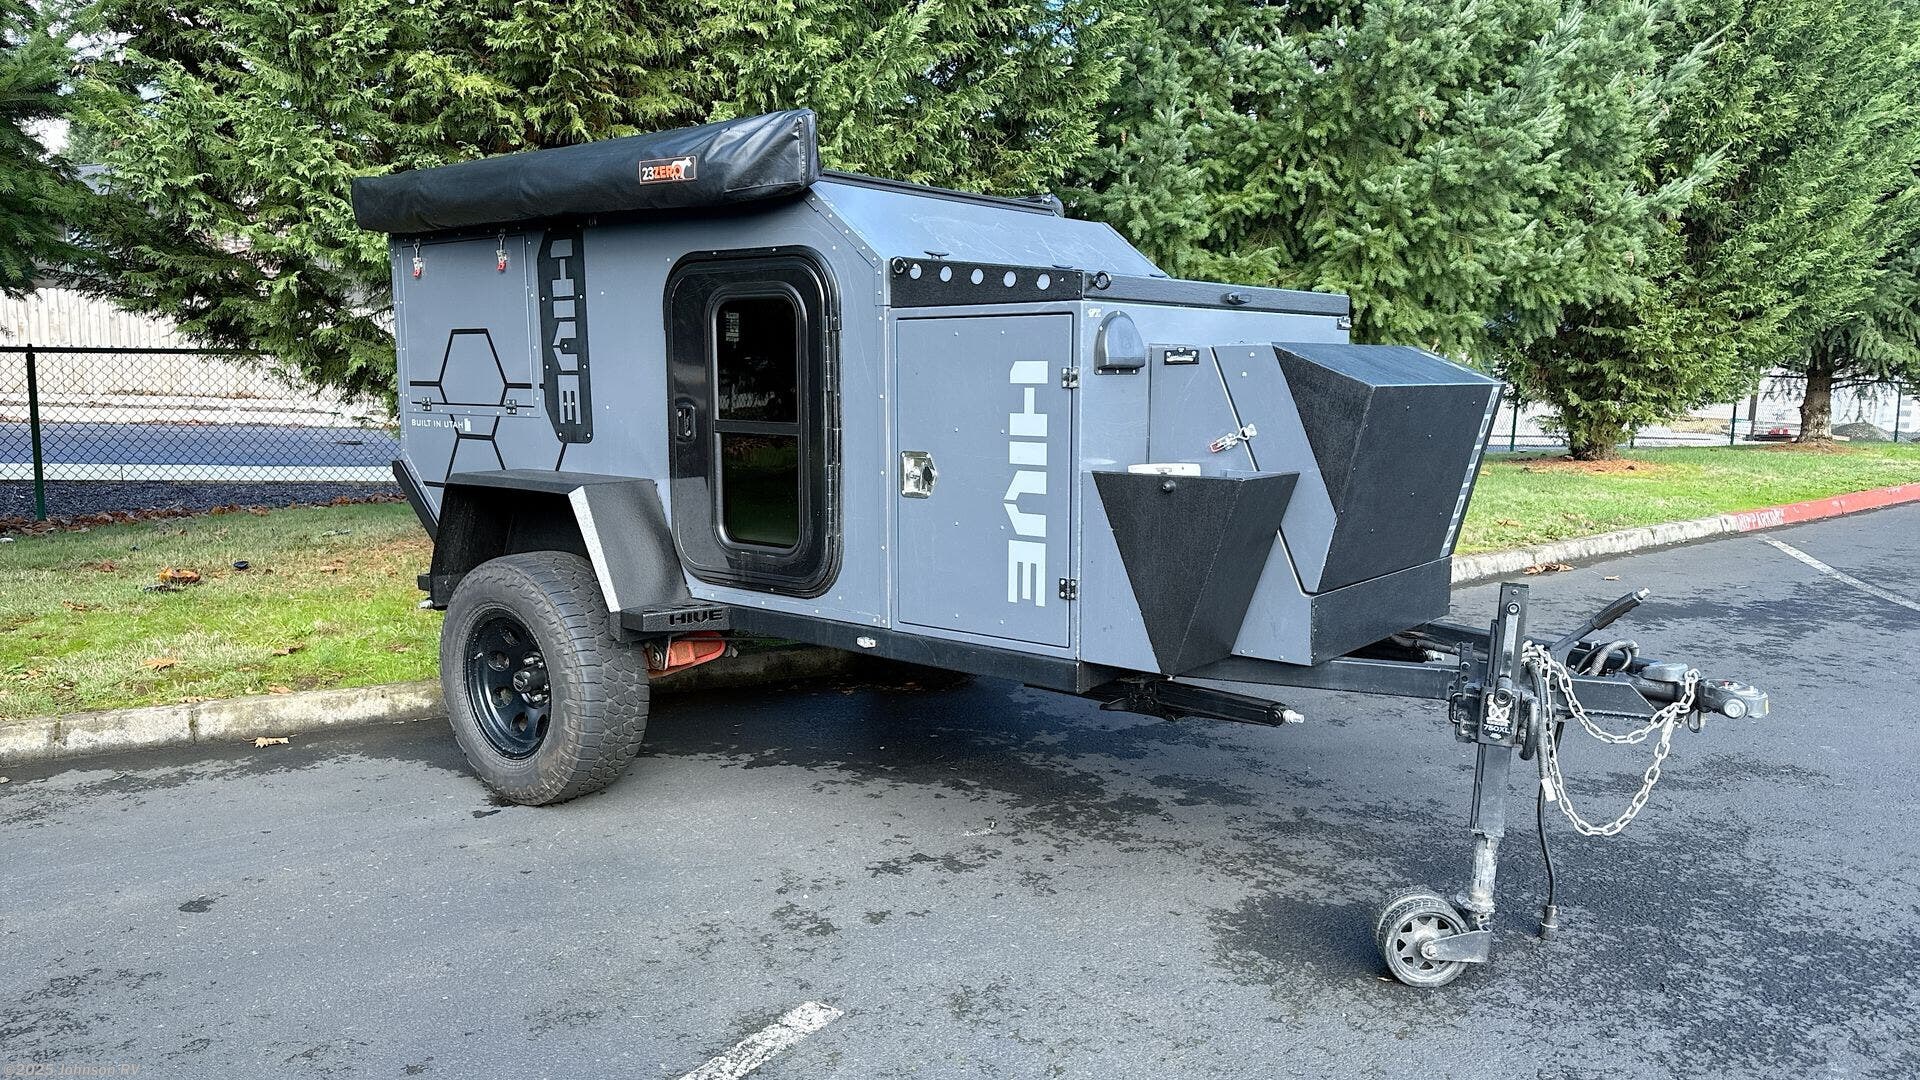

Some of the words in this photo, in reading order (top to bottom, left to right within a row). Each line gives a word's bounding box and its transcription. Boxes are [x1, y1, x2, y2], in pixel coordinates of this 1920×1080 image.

[641, 164, 682, 181] 23ZERO
[550, 238, 582, 425] HIVE
[411, 418, 431, 427] BUILT
[433, 420, 441, 428] IN
[443, 420, 464, 429] UTAH
[1003, 360, 1049, 607] HIVE
[669, 609, 723, 626] HIVE
